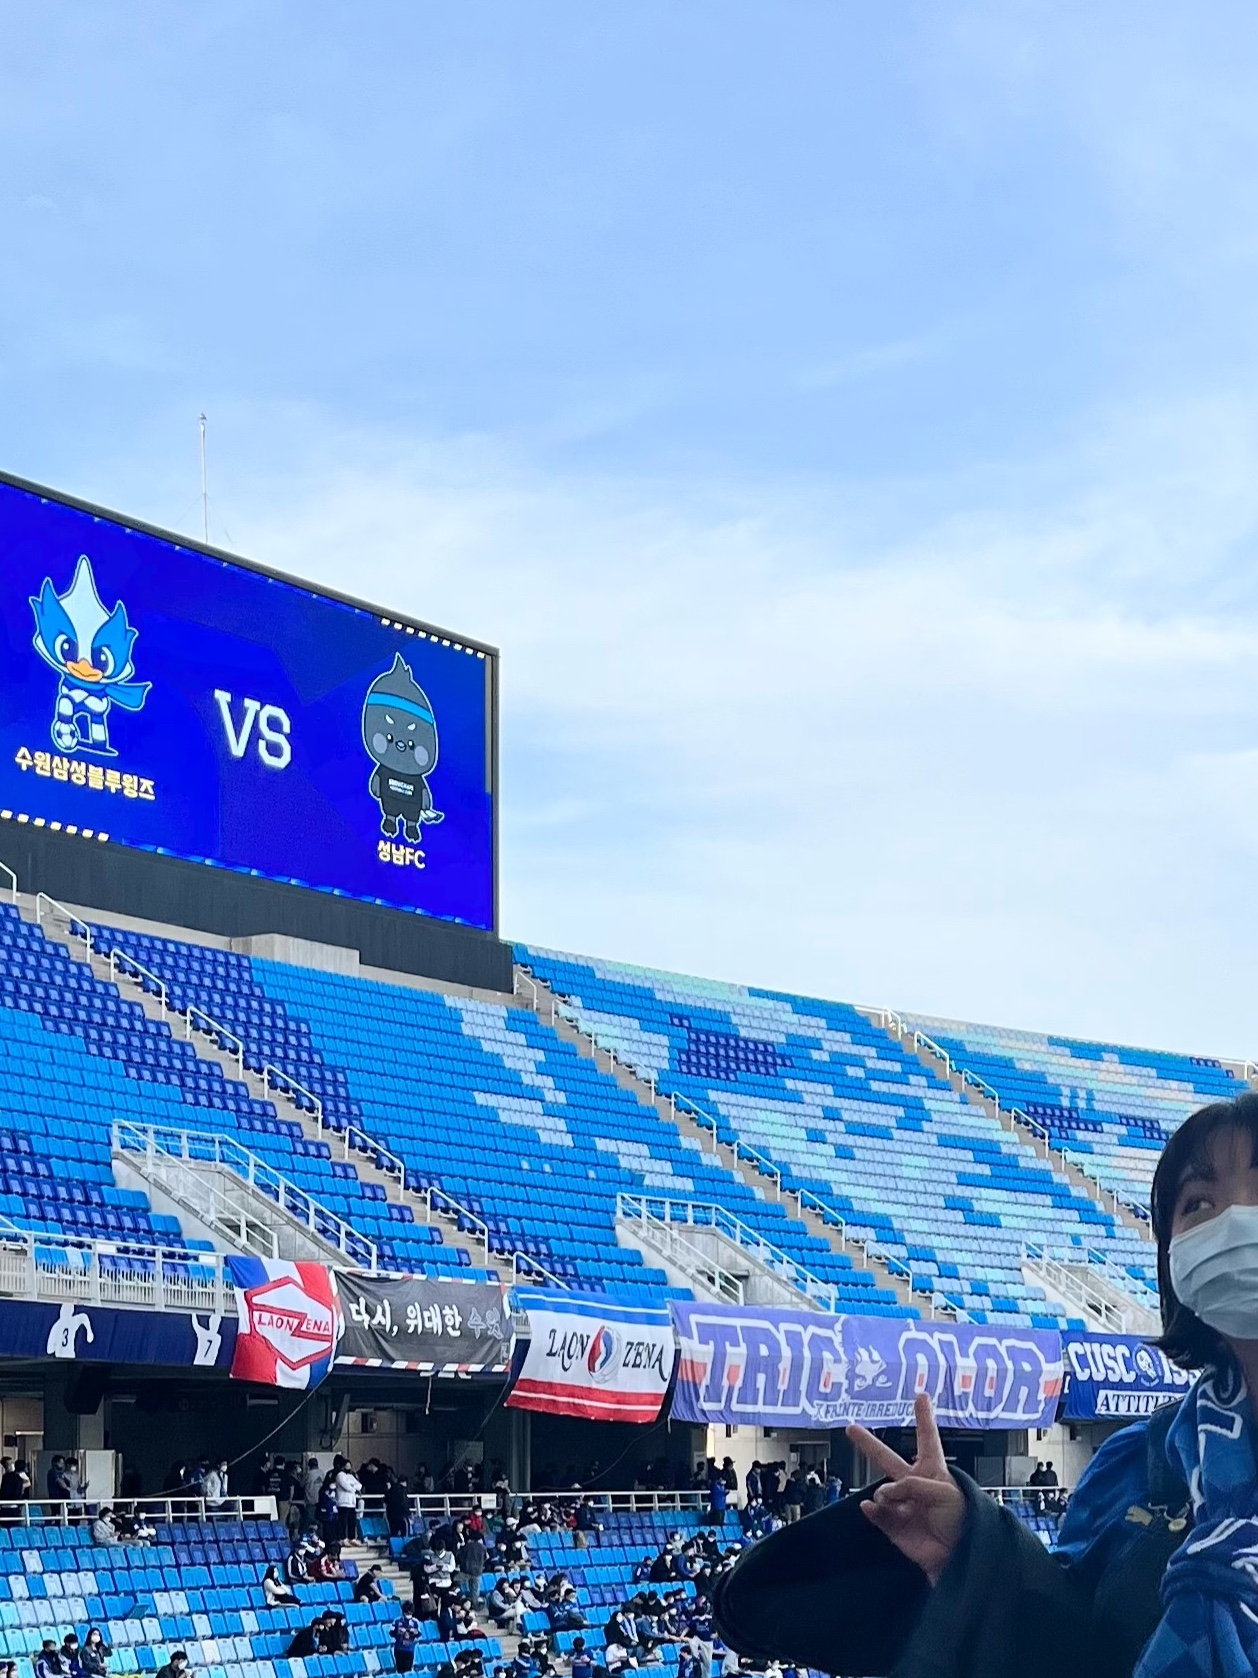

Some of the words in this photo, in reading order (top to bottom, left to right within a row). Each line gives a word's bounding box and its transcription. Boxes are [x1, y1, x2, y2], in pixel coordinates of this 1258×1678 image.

[213, 688, 292, 770] VS
[14, 746, 156, 801] 수원삼성블루윙즈
[377, 839, 426, 869] 성남FC
[61, 1327, 70, 1348] 3
[349, 1296, 399, 1338] 다시,
[405, 1301, 463, 1338] 위대한
[203, 1338, 214, 1359] 7
[546, 1328, 591, 1373] LAON
[622, 1341, 671, 1383] ZENA
